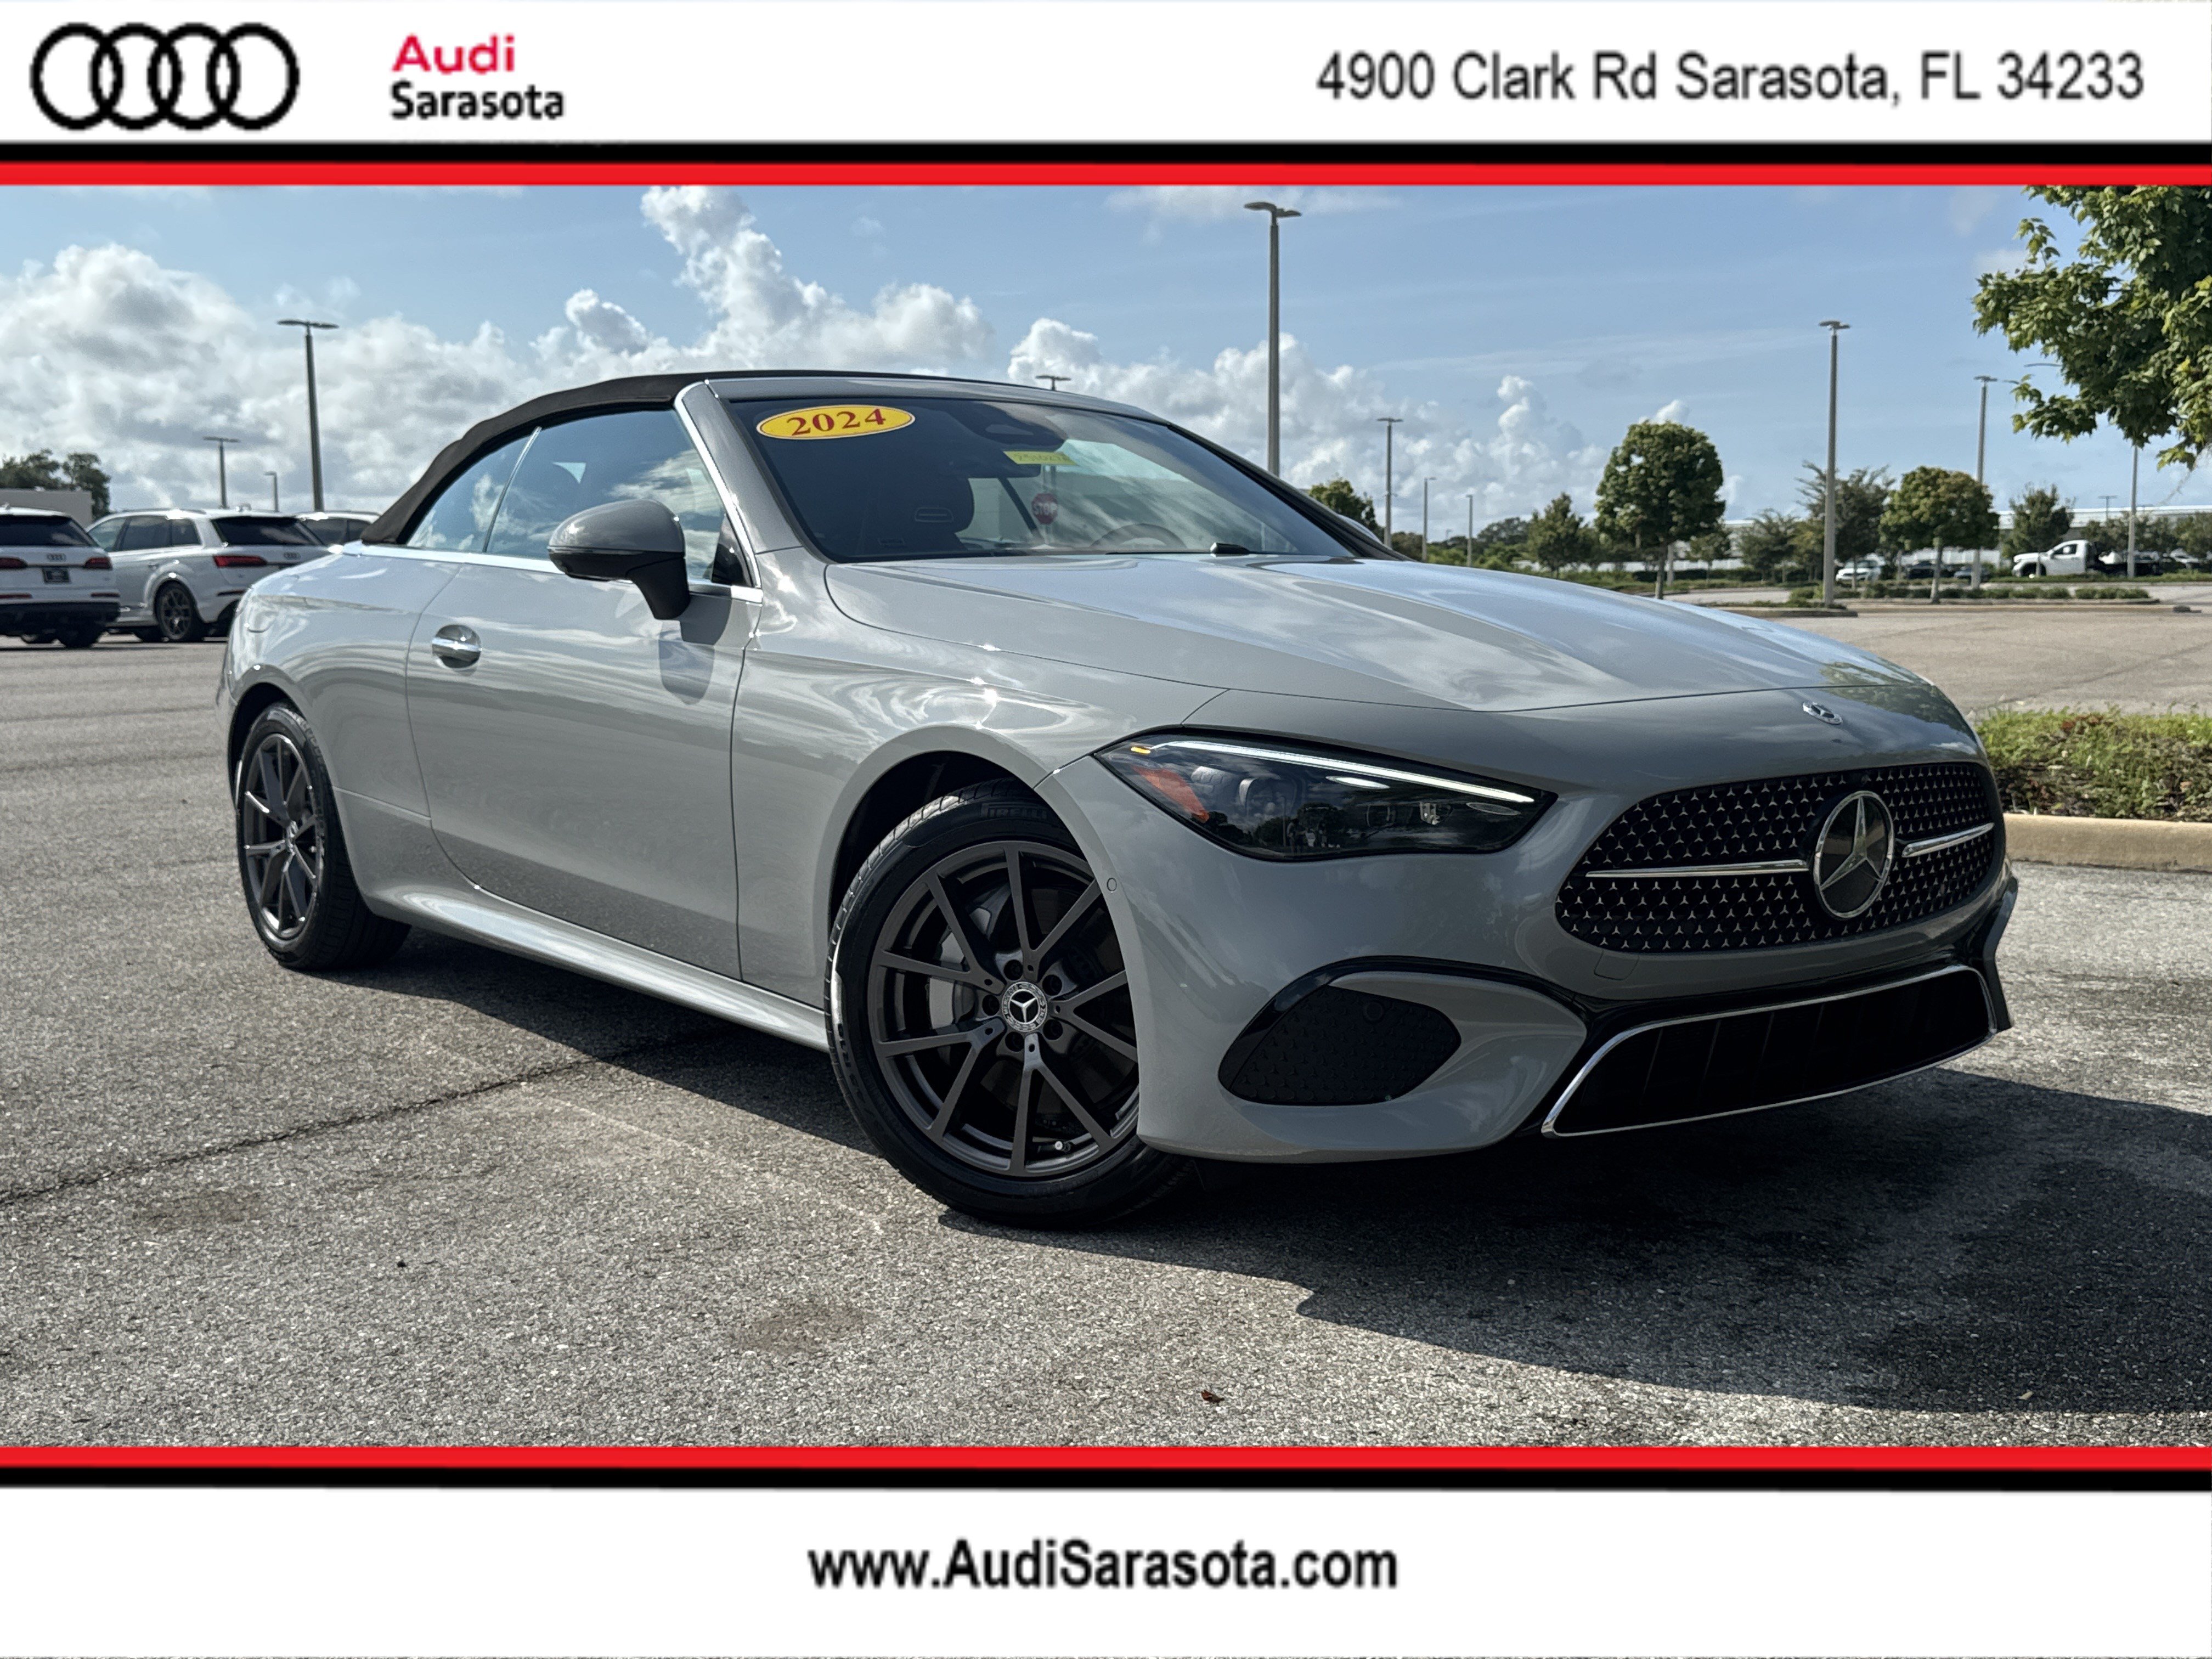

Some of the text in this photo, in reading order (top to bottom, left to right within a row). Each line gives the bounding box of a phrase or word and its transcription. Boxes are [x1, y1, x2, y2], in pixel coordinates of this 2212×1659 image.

[786, 408, 887, 436] 2024
[1033, 500, 1058, 516] STOP
[979, 802, 1047, 820] PIRELLI
